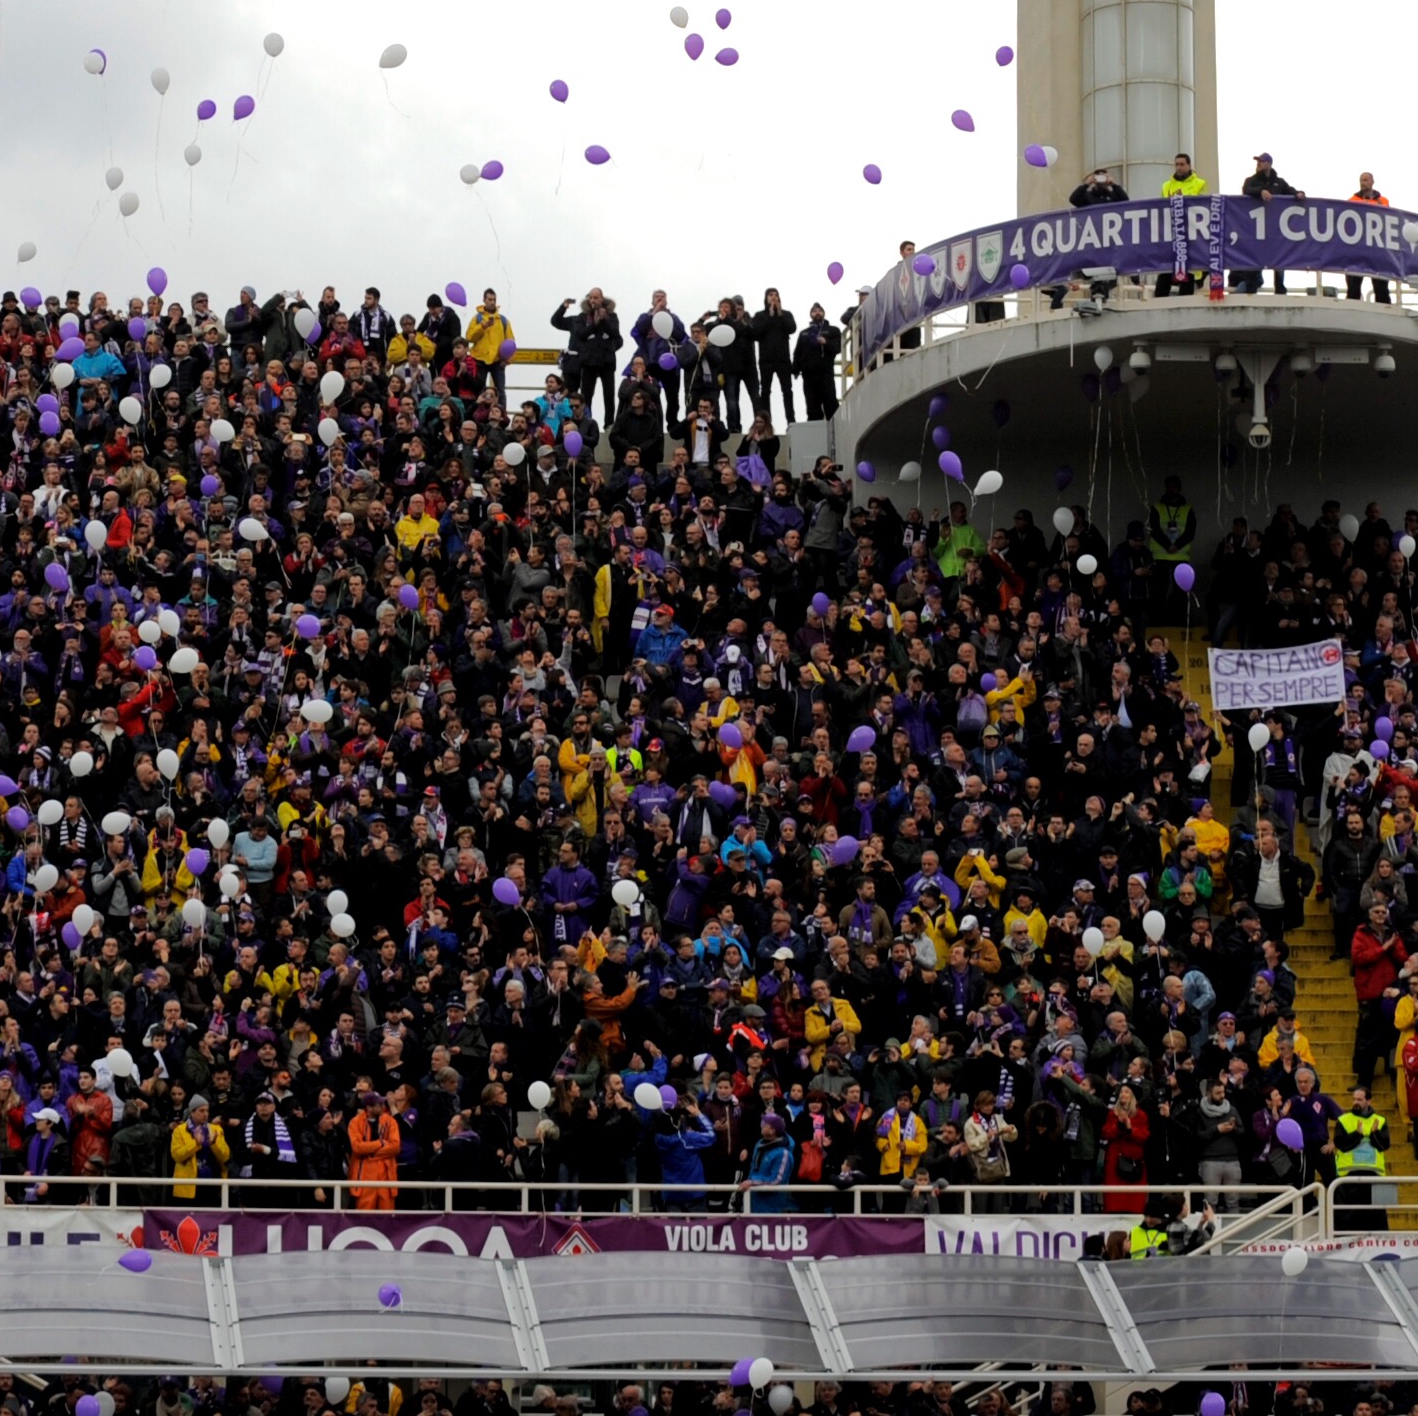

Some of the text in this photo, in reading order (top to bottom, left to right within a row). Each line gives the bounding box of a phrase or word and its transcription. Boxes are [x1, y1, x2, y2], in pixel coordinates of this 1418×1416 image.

[1009, 228, 1026, 261] 4
[1248, 206, 1266, 240] 1
[1279, 205, 1400, 251] CUORE
[664, 1223, 809, 1253] VIOLA CLUB
[1348, 1239, 1397, 1249] centro
